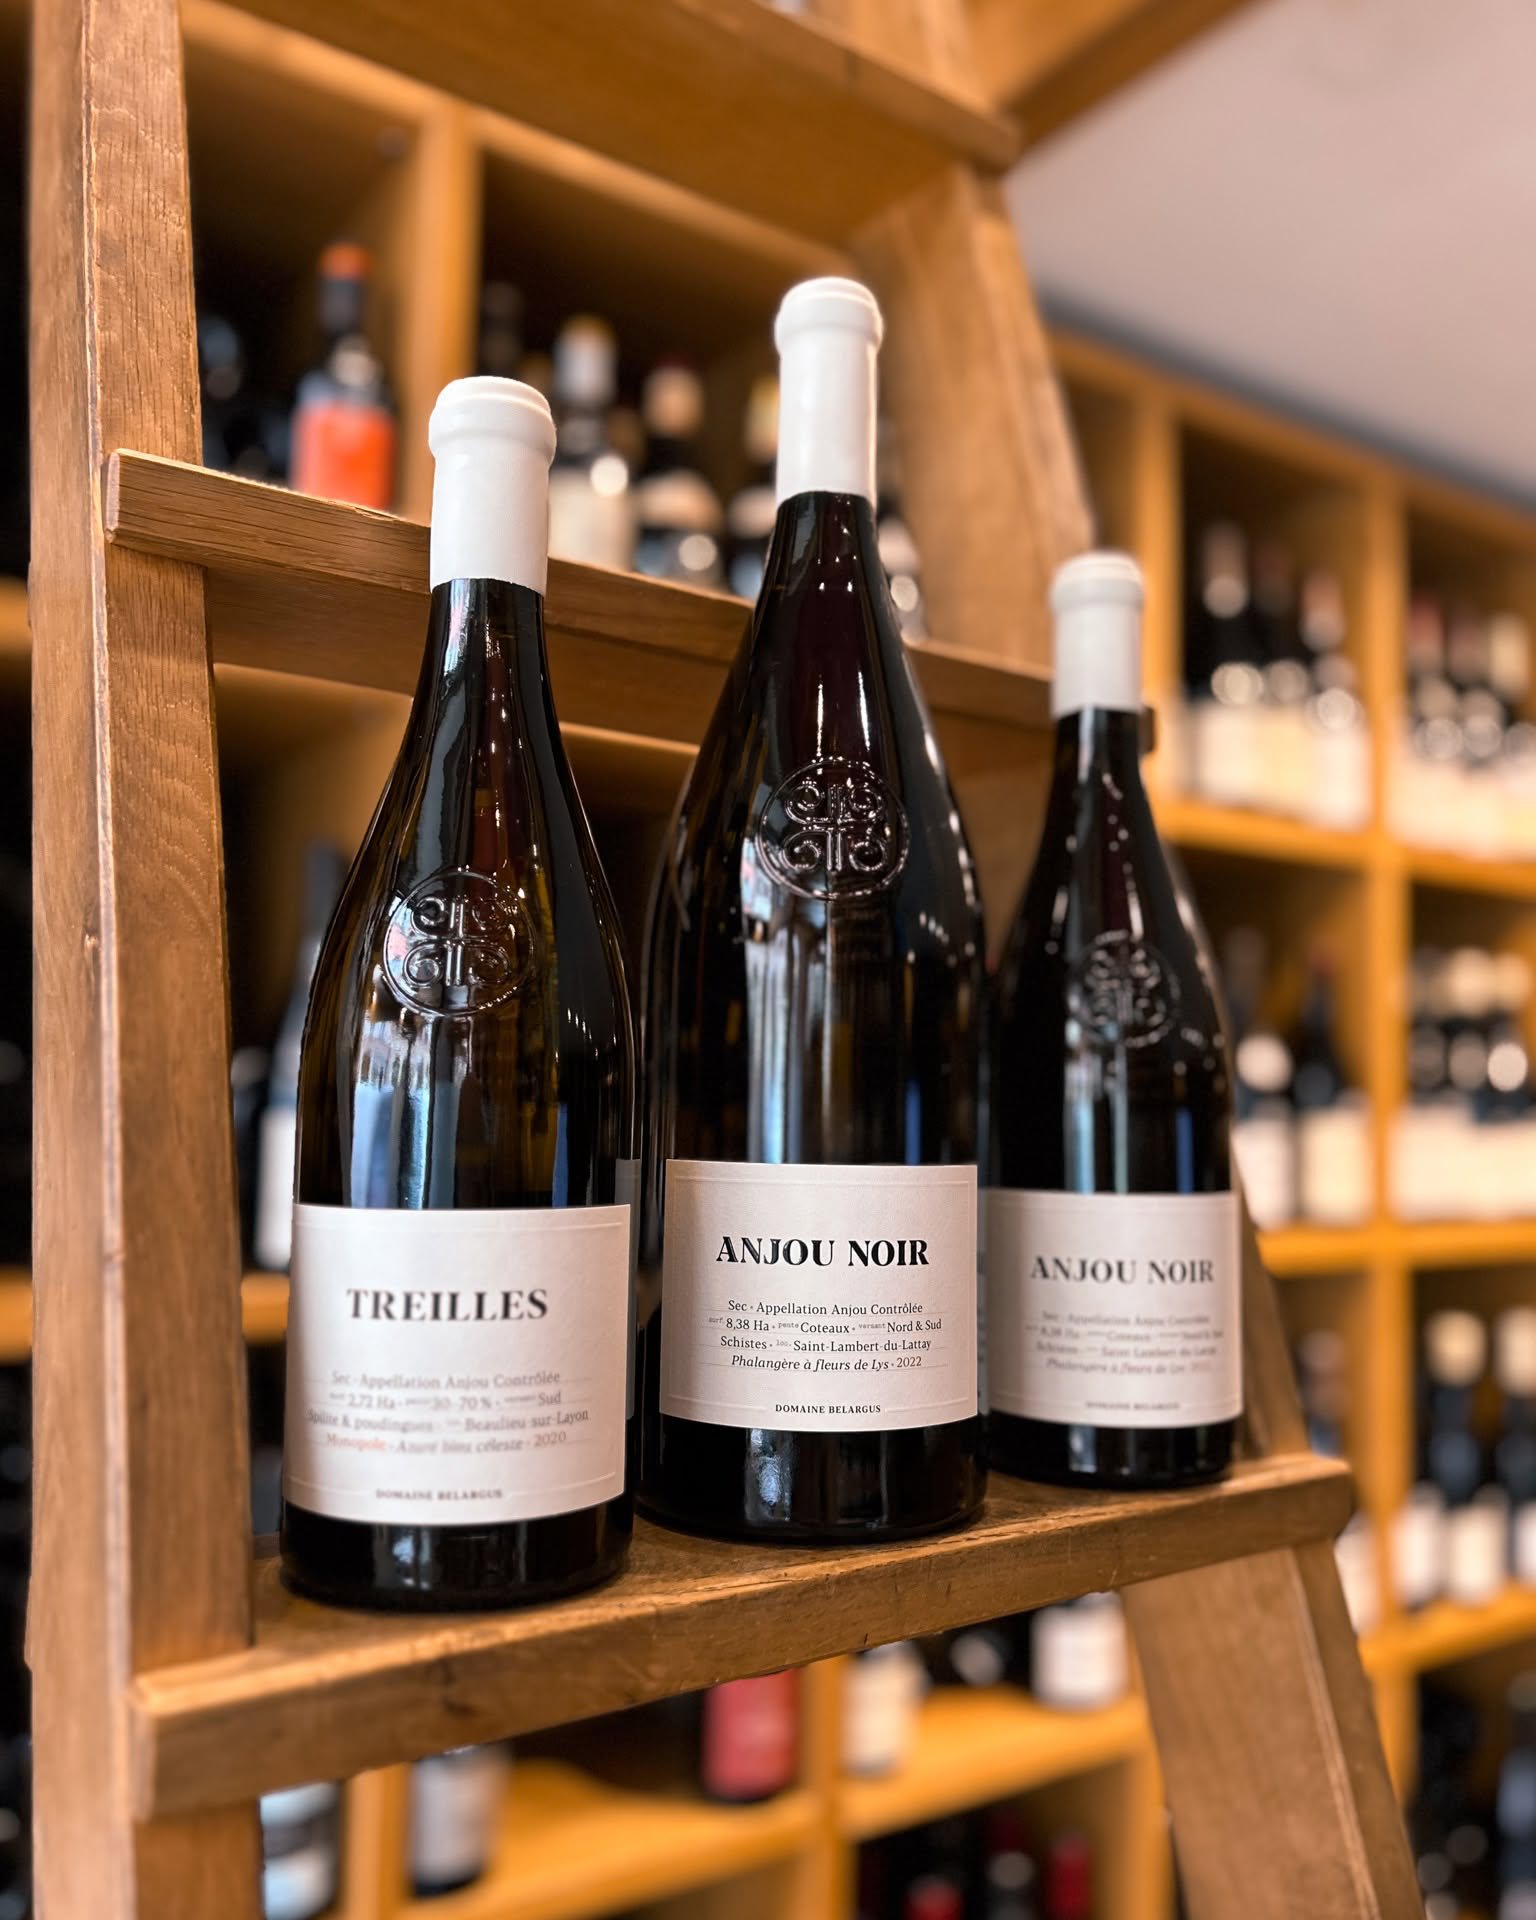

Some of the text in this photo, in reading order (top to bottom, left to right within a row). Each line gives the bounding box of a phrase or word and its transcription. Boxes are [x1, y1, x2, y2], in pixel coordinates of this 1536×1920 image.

[716, 1236, 930, 1267] ANJOU NOIR
[1031, 1256, 1215, 1284] ANJOU NOIR
[346, 1288, 548, 1321] TREILLES
[728, 1300, 923, 1317] Sec Appellation Anjou Contrôlée
[726, 1318, 750, 1331] 8,38
[753, 1320, 769, 1331] Ha
[800, 1322, 850, 1333] Coteaux
[887, 1321, 913, 1333] Nord
[915, 1320, 923, 1331] &
[925, 1318, 942, 1330] Sud
[720, 1336, 767, 1349] Schistes
[793, 1339, 932, 1353] Saint-Lambert-du-Lattay
[731, 1355, 922, 1373] Phalangère à fleurs de Lys 2022
[361, 1373, 440, 1390] Appellation
[446, 1374, 489, 1390] Anjou
[493, 1371, 561, 1387] Contrôlée
[538, 1390, 562, 1406] Sud
[775, 1404, 881, 1414] DOMAINE BELARGUS
[534, 1431, 567, 1448] 2020
[376, 1488, 432, 1500] DOMAINE
